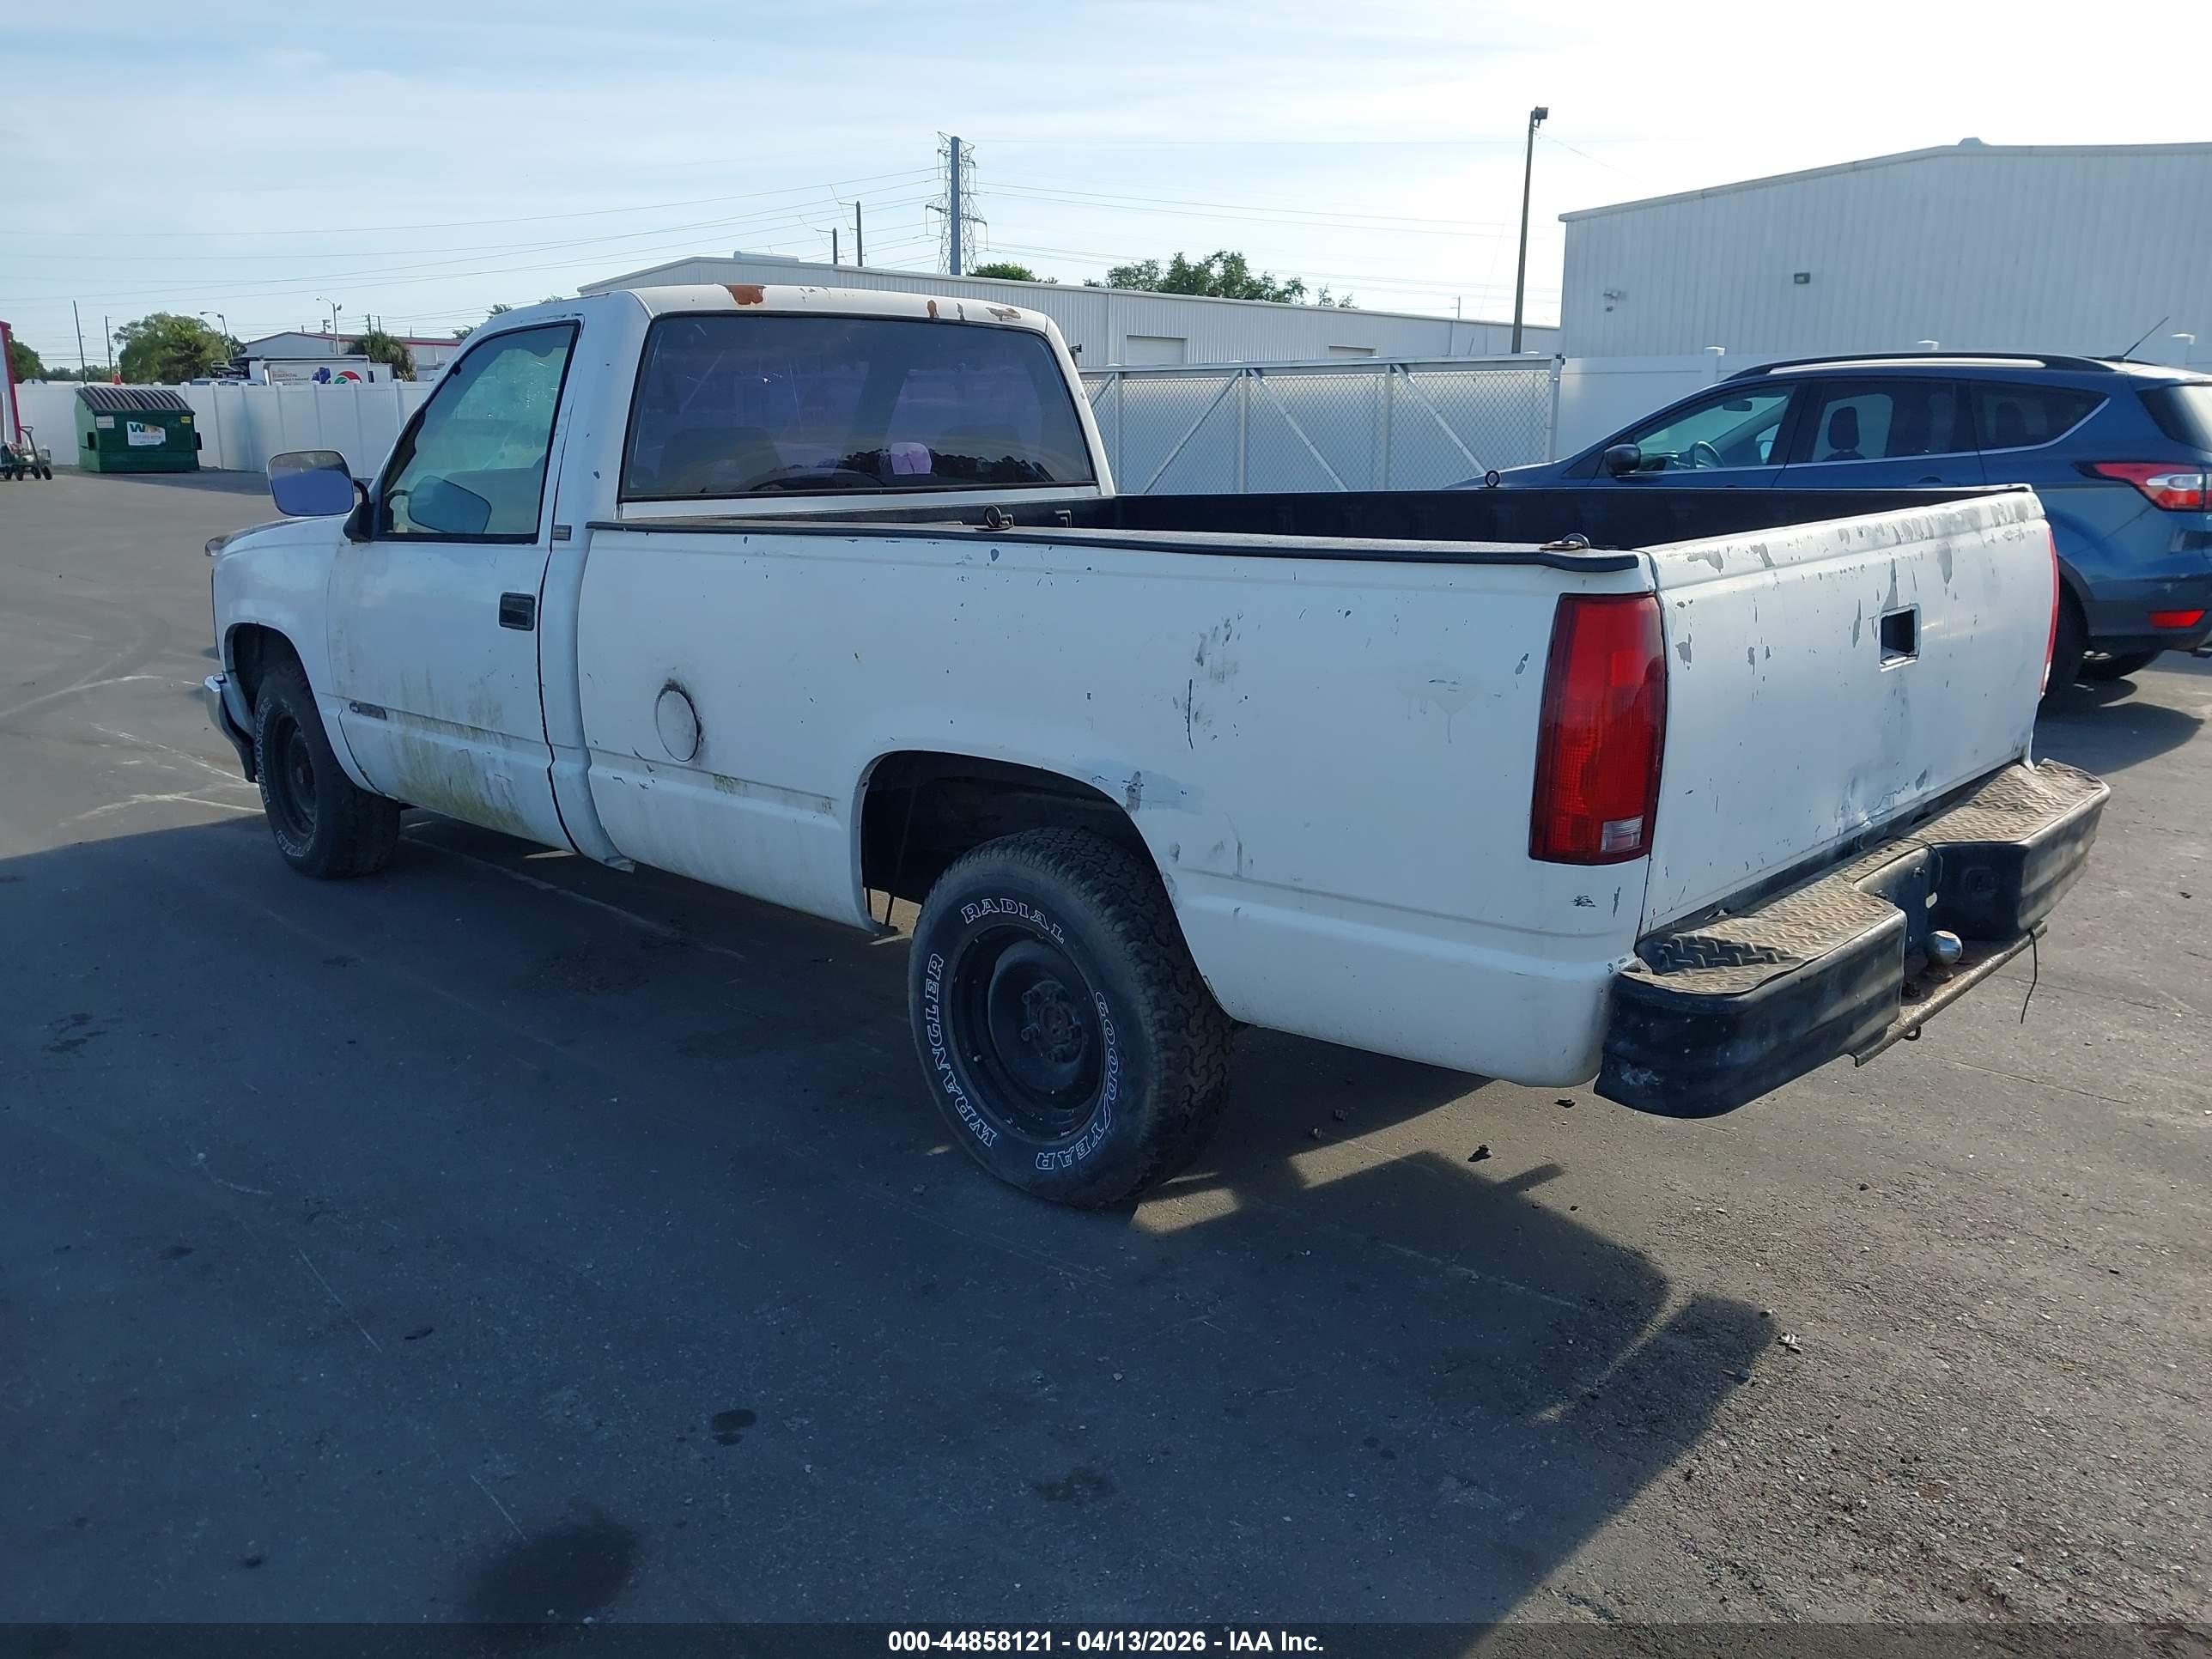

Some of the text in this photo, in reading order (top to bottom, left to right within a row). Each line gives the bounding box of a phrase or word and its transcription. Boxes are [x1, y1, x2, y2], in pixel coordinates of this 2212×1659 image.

[960, 897, 1066, 945] RADIAL
[925, 953, 998, 1147] WRANGLER
[1036, 991, 1120, 1170] GOODYEAR
